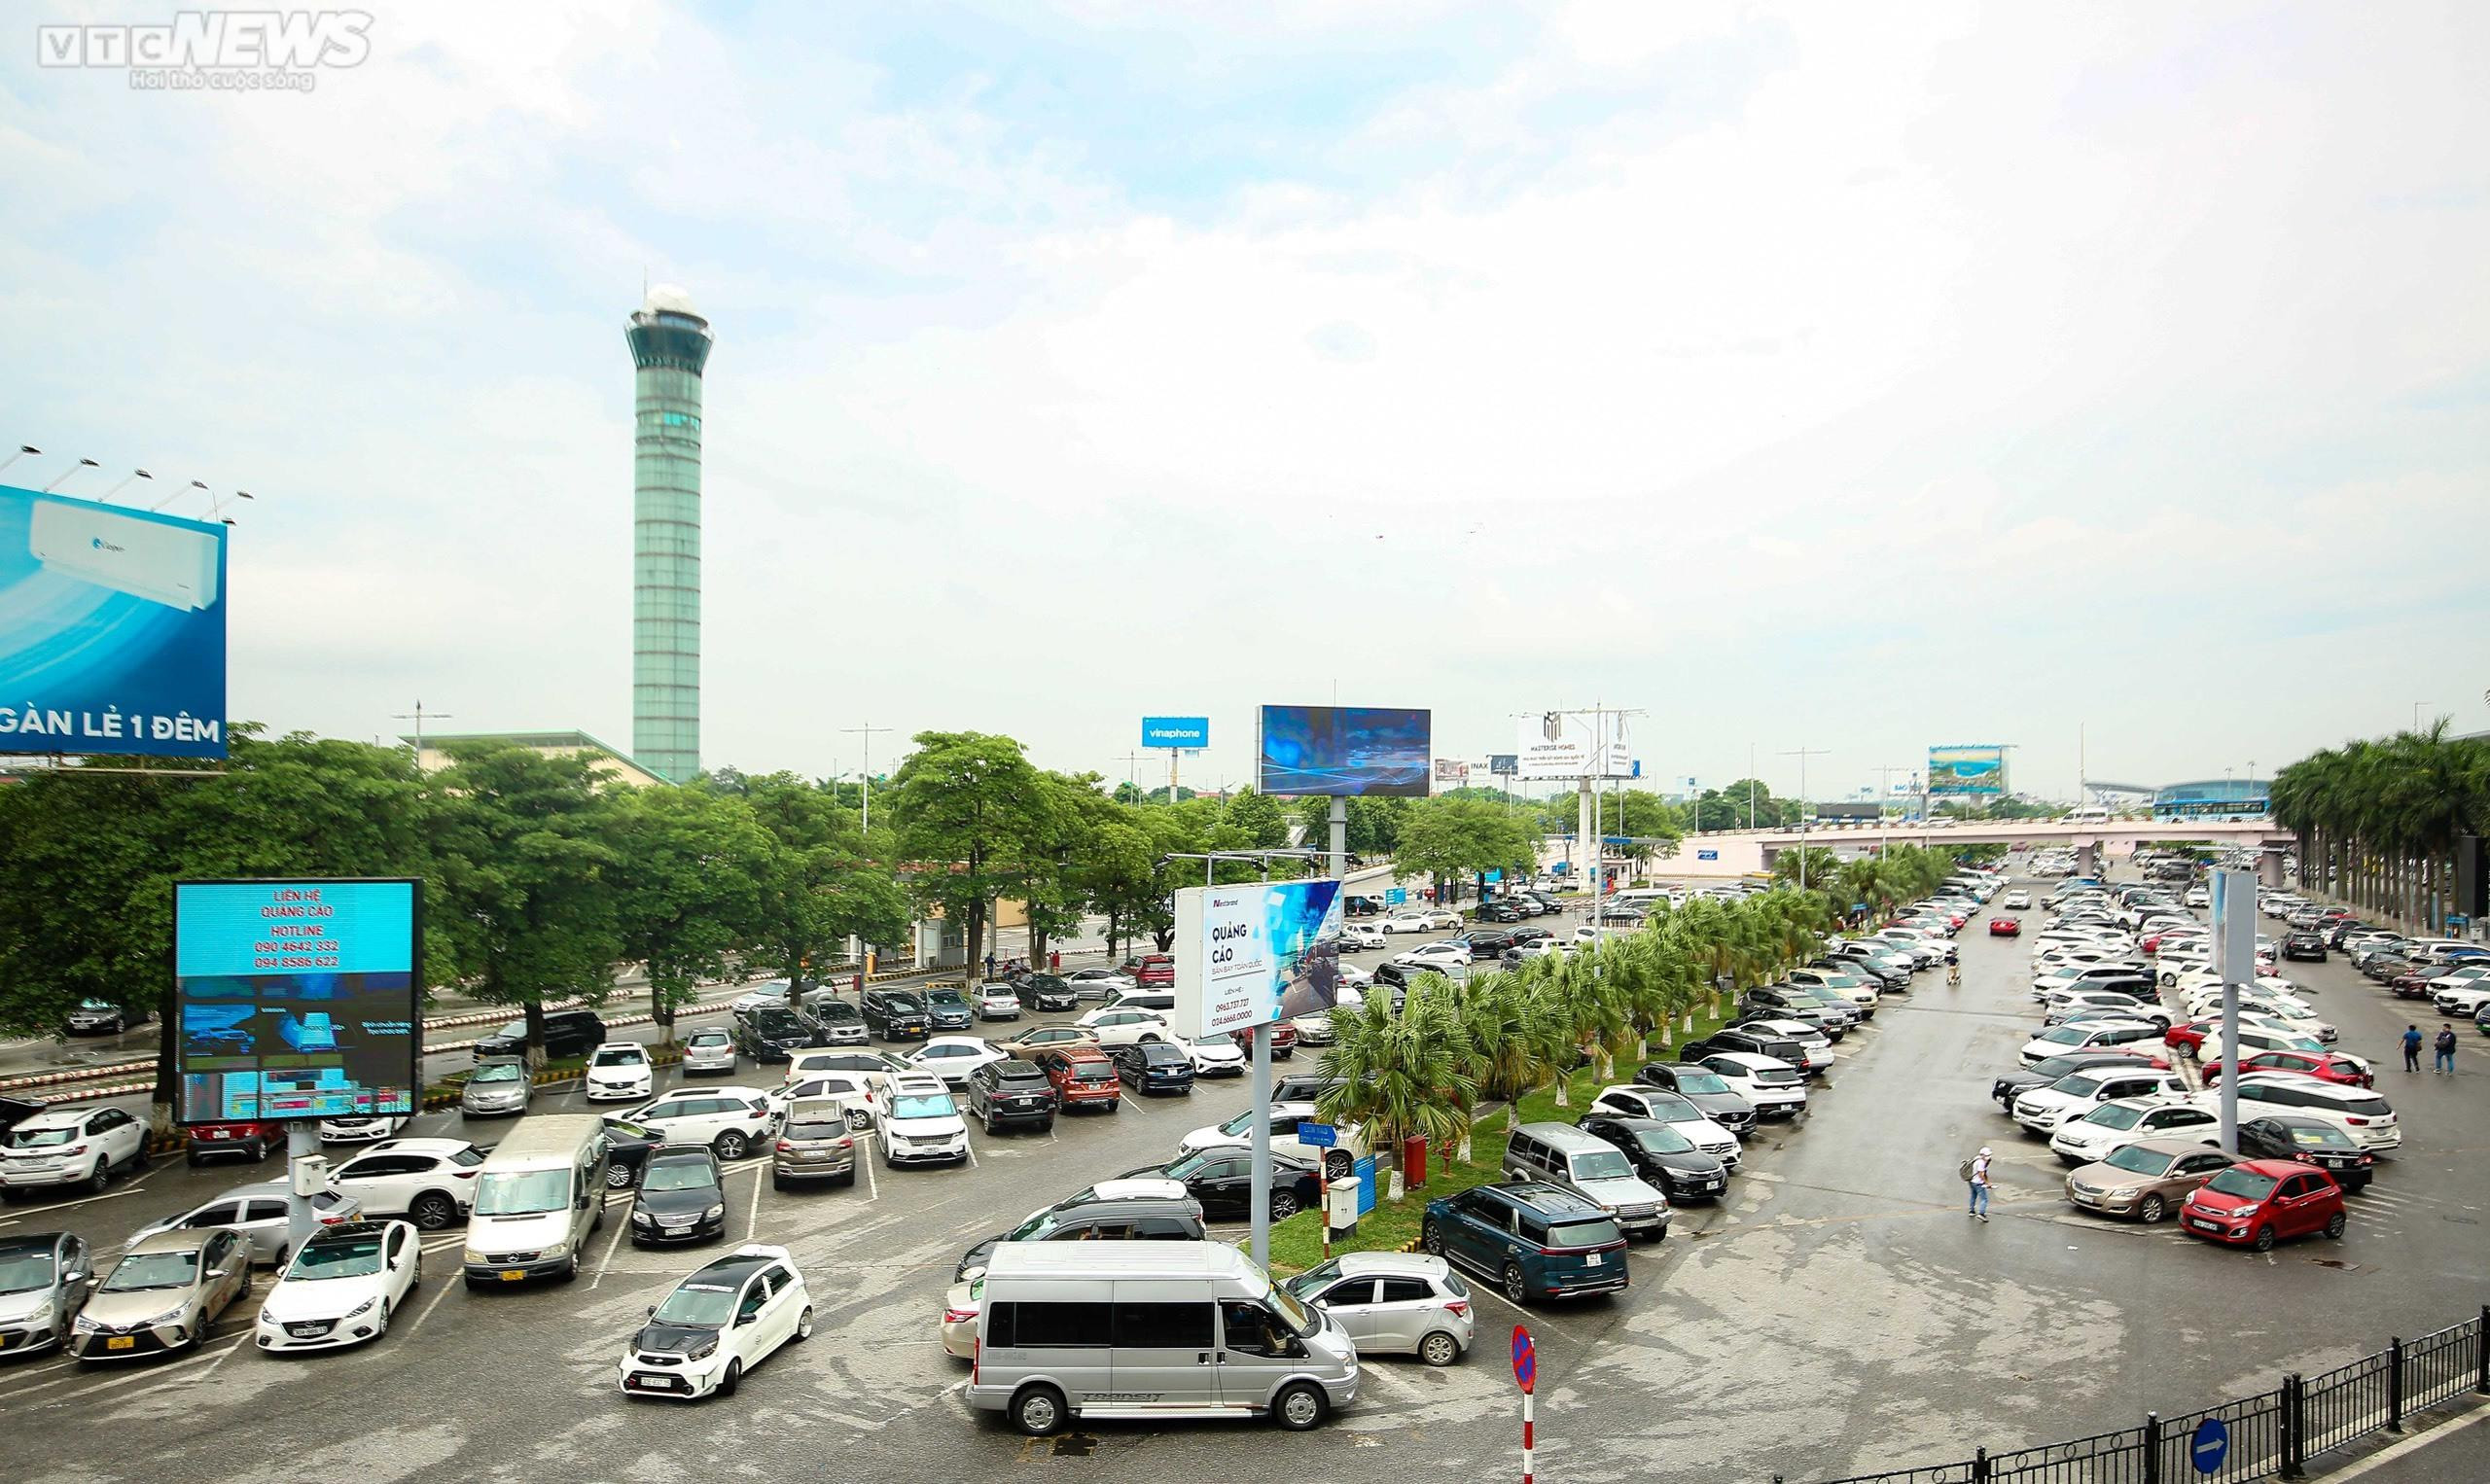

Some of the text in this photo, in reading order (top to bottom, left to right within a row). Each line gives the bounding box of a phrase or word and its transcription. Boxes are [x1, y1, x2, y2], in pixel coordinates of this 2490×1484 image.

[83, 704, 123, 738] LẺ
[130, 714, 143, 739] 1
[151, 710, 220, 743] ĐÊM
[1149, 727, 1200, 740] vinaphone
[273, 888, 301, 902] LIÊN
[261, 902, 333, 918] QUẢNG CÁO
[270, 925, 324, 936] HOTLINE
[1212, 920, 1247, 943] QUẢNG
[255, 940, 278, 952] 090
[1212, 944, 1233, 964] CÁO
[255, 957, 278, 969] 094
[1082, 1393, 1165, 1402] TRANSIT
